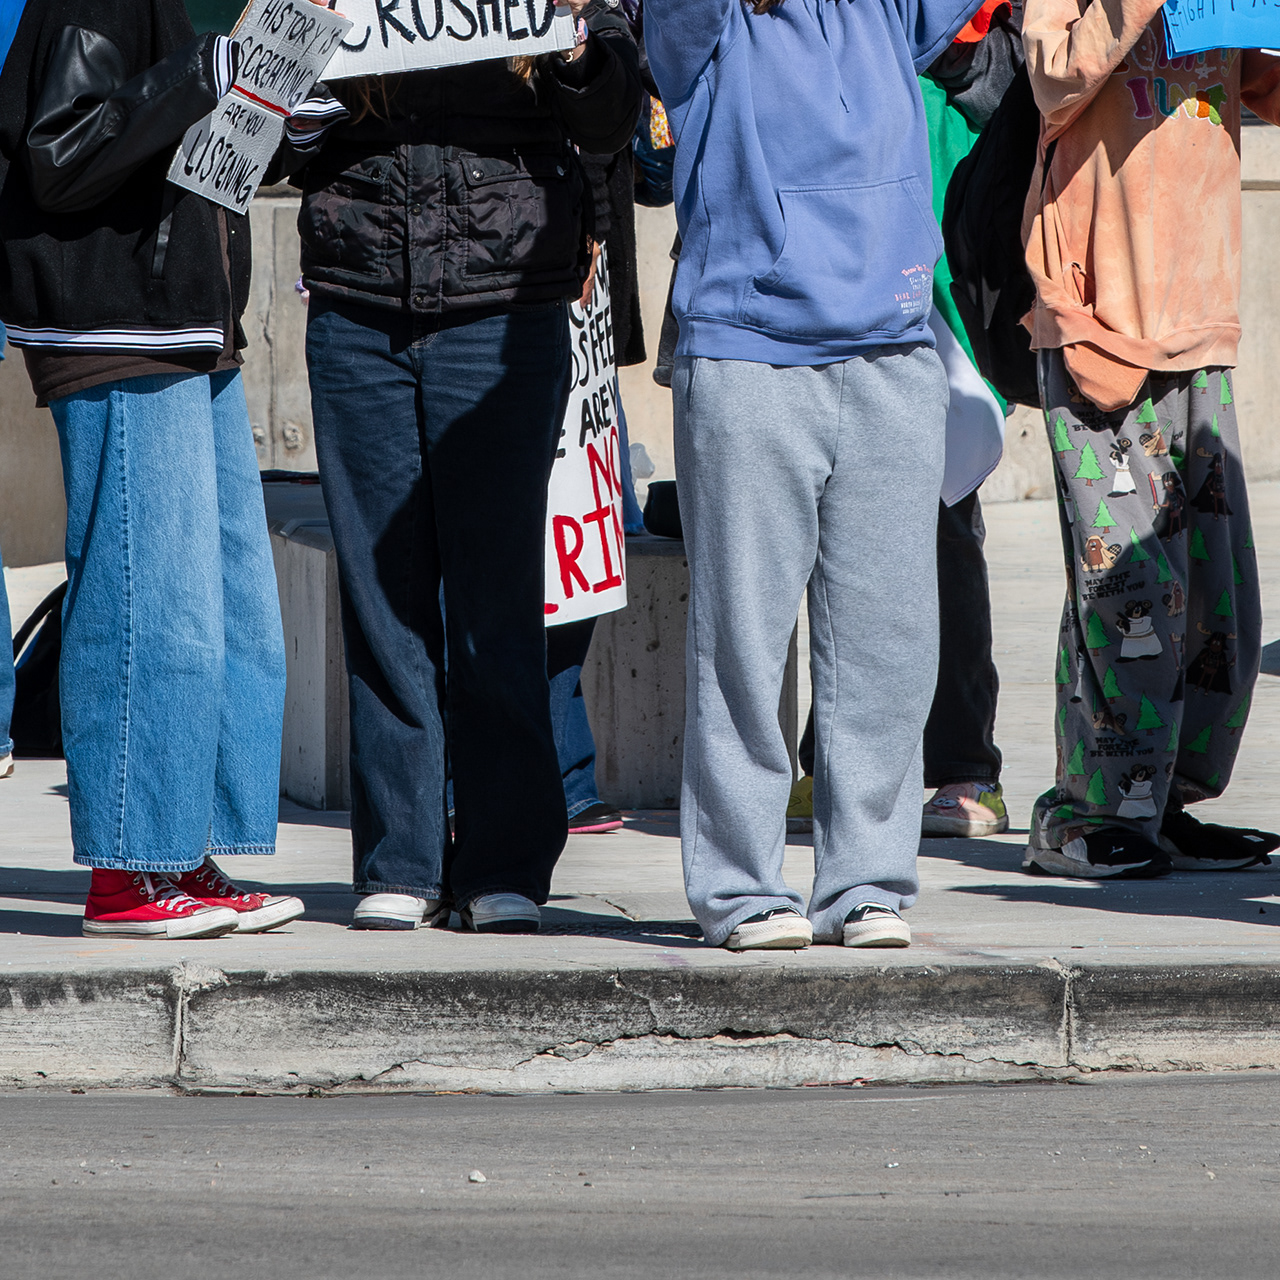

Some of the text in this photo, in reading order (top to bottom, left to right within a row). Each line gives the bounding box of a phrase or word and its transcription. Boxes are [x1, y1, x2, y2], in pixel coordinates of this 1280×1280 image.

[237, 36, 312, 107] SCREAMING
[221, 103, 267, 137] ARE YOU
[184, 129, 259, 206] LISTENING
[579, 383, 611, 447] ARE
[1085, 578, 1103, 587] MAY
